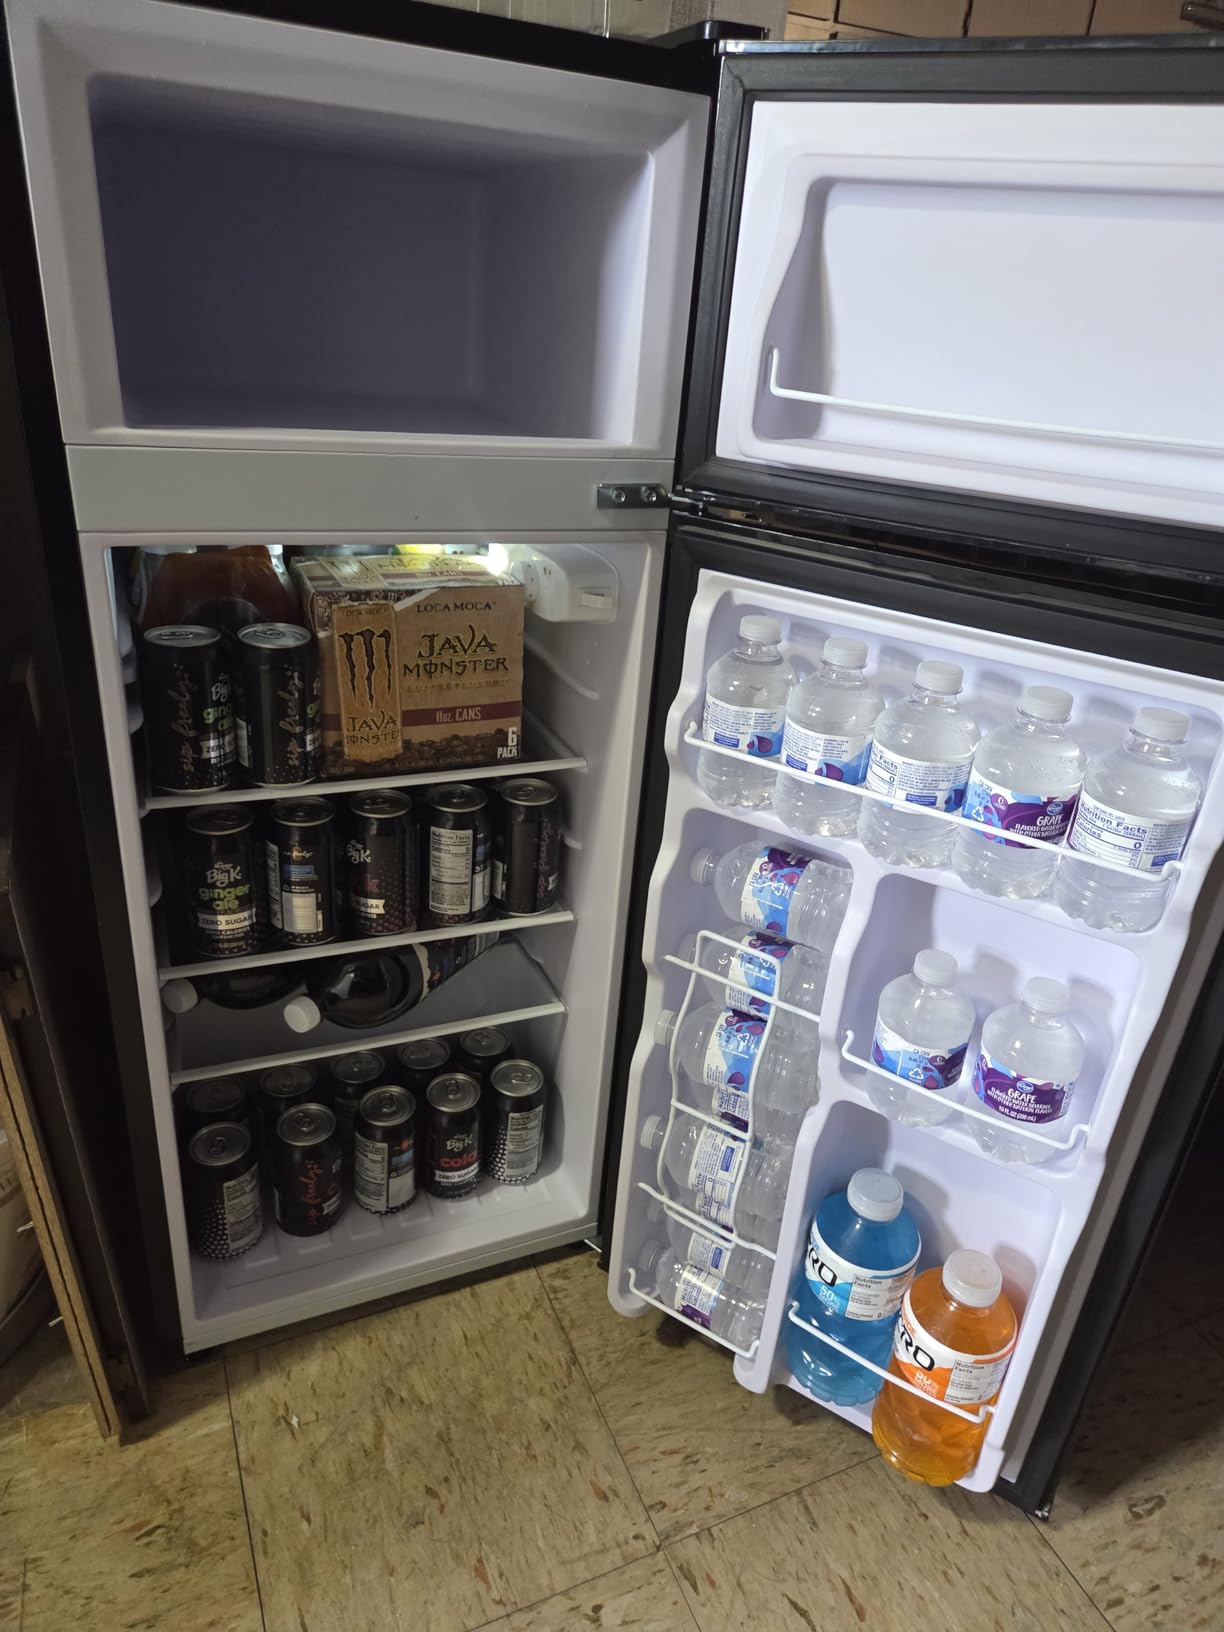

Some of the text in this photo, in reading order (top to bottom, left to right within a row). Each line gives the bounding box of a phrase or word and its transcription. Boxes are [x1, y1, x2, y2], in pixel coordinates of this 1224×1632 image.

[417, 601, 492, 613] LOCA MOCA
[418, 624, 497, 659] JAVA
[403, 657, 509, 679] MONSTER
[347, 711, 397, 733] JAVA
[455, 707, 481, 721] CANS
[347, 730, 399, 745] ONSTE
[507, 727, 517, 746] 6
[497, 745, 518, 759] PACK
[1080, 801, 1113, 826] Nutrition
[1116, 821, 1148, 835] Facts
[1075, 819, 1102, 839] Calories
[1133, 842, 1142, 850] 0
[198, 884, 250, 900] ginger
[212, 898, 240, 911] ale
[1007, 1088, 1037, 1104] GRAPE
[445, 1138, 464, 1152] Big
[439, 1151, 478, 1168] cola
[808, 1246, 838, 1288] RO
[854, 1281, 871, 1289] Facts
[855, 1275, 883, 1285] Nutrition
[899, 1323, 935, 1371] RO
[956, 1361, 985, 1370] Nutrition
